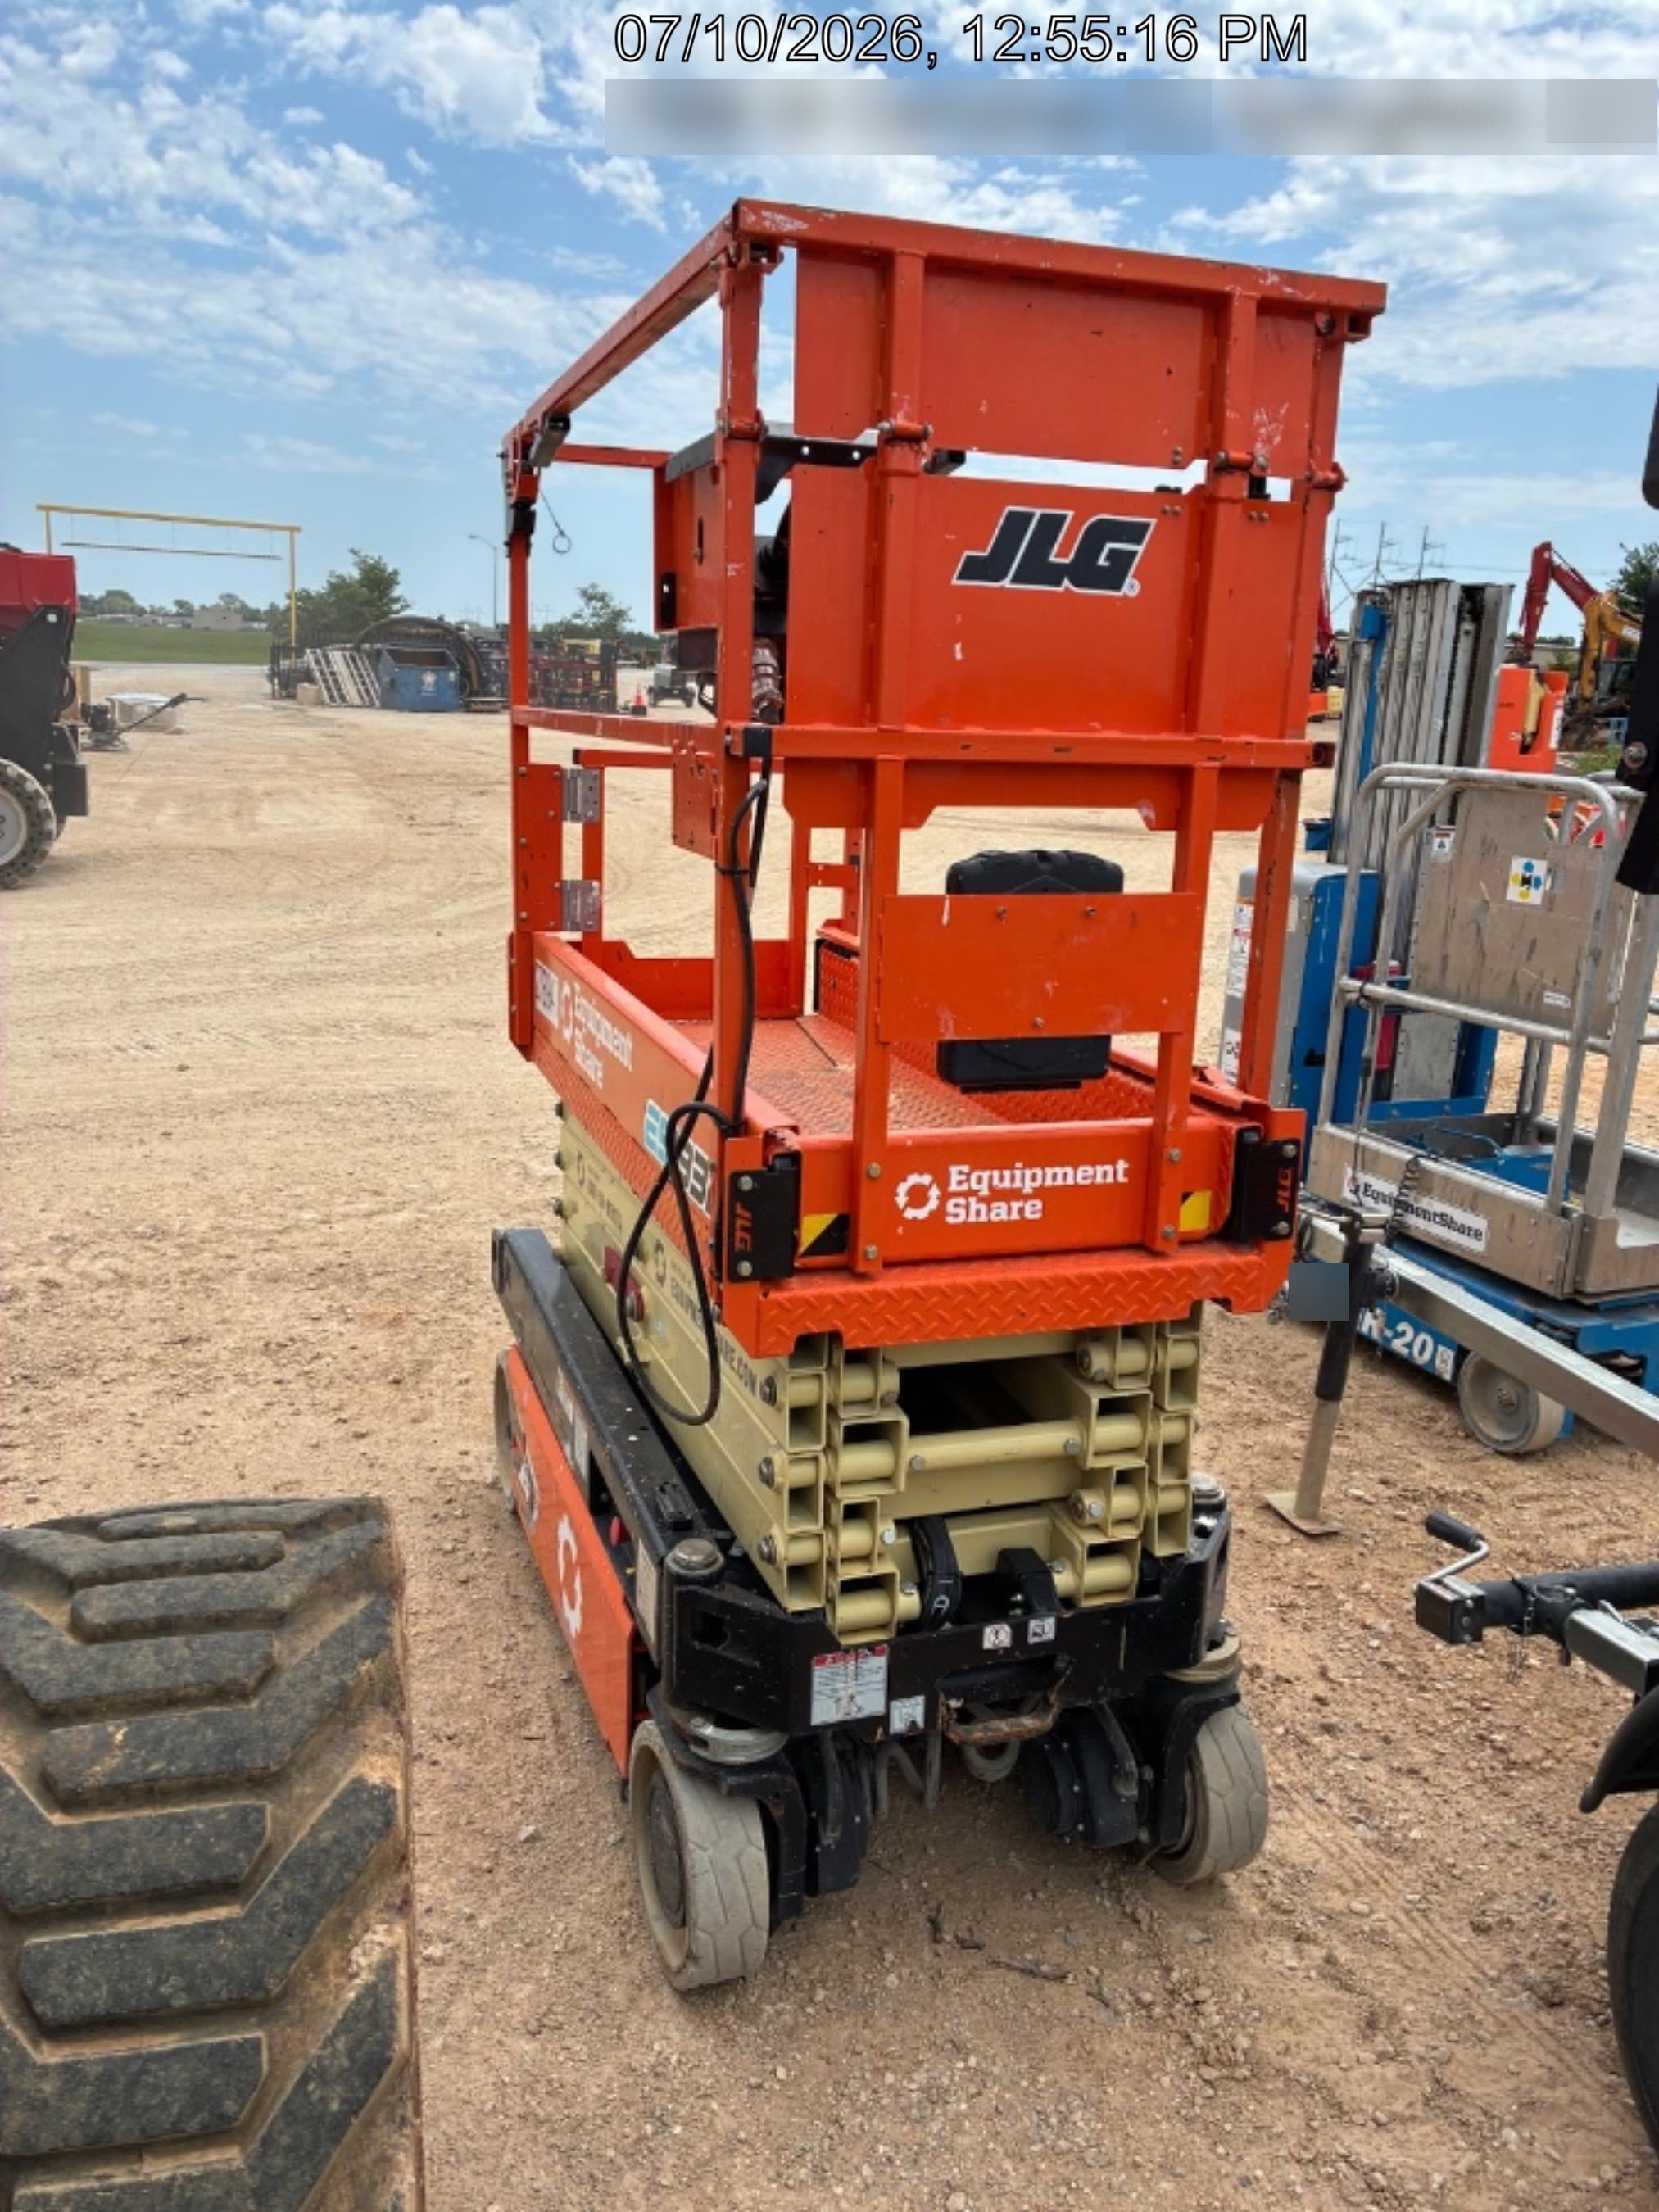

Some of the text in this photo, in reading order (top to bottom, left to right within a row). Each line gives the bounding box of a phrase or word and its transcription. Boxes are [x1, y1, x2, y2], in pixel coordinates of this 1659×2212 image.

[950, 505, 1158, 596] JLG
[947, 1158, 1130, 1196] Equipment
[734, 1201, 753, 1252] JLG
[945, 1196, 1044, 1225] Share
